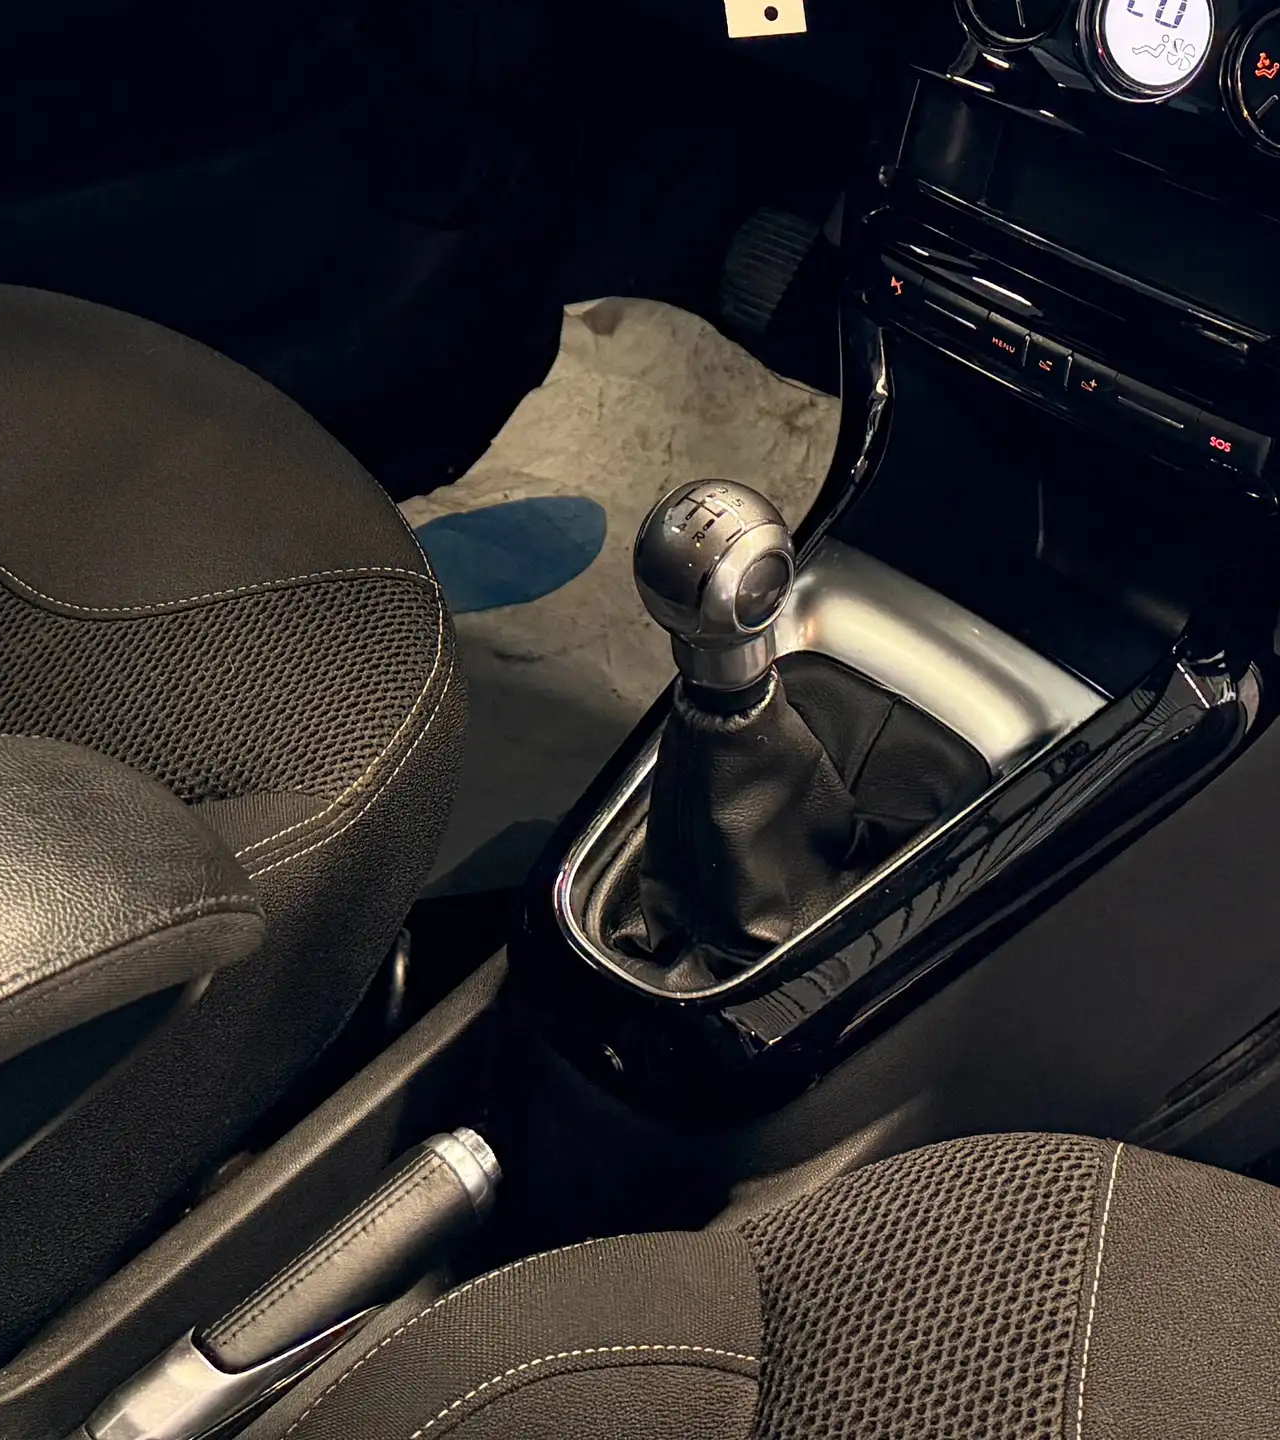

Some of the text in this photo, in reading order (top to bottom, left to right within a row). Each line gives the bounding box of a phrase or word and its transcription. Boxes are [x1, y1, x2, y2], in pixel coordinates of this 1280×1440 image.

[991, 336, 1016, 354] MENU
[1209, 434, 1232, 453] SOS
[691, 530, 706, 544] R
